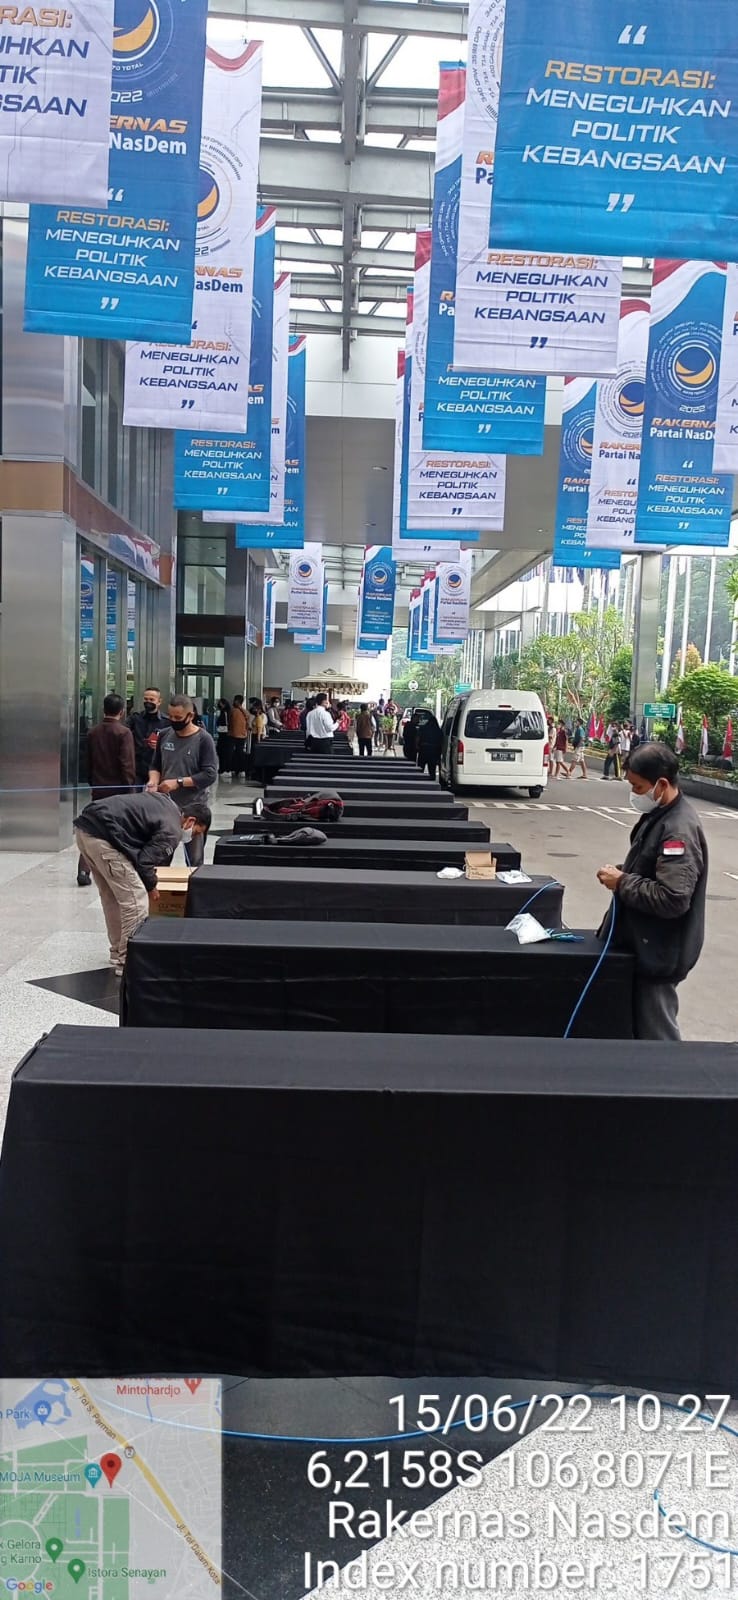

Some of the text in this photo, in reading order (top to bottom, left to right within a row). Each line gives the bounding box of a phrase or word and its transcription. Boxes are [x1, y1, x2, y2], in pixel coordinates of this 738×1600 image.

[543, 60, 716, 89] RESTORASI:
[0, 94, 88, 117] SAAN
[526, 88, 731, 118] MENEGUHKAN
[571, 120, 681, 144] POLITIK
[109, 131, 187, 155] NasDem
[522, 145, 726, 175] KEBANGSAAN
[56, 211, 170, 231] RESTORASI:
[46, 229, 181, 251] MENEGUHKAN
[75, 249, 147, 268] POLITIK
[486, 252, 599, 269] RESTORASI:
[44, 266, 178, 287] KEBANGSAAN
[476, 271, 608, 288] MENEGUHKAN
[506, 291, 576, 304] POLITIK
[475, 307, 606, 324] KEBANGSAAN
[140, 350, 239, 365] MENEGUHKAN
[163, 365, 215, 377] POLITIK
[139, 377, 238, 392] KEBANGSAAN
[438, 376, 536, 388] MENEGUHKAN
[460, 391, 512, 401] POLITIK
[437, 403, 534, 415] KEBANGSAAN
[649, 428, 683, 440] Partai
[190, 439, 256, 450] RESTORASI:
[184, 450, 262, 460] MENEGUHKAN
[598, 450, 627, 460] Partai
[202, 460, 244, 470] POLITIK
[425, 460, 491, 469] RESTORASI:
[184, 470, 262, 480] KEBANGSAAN
[419, 471, 497, 479] MENEGUHKAN
[655, 474, 720, 486] RESTORASI:
[437, 481, 478, 489] POLITIK
[562, 485, 586, 493] Partai
[648, 484, 725, 495] MENEGUHKAN
[419, 492, 496, 500] KEBANGSAAN
[665, 495, 706, 505] POLITIK
[647, 505, 723, 516] KEBANGSAAN
